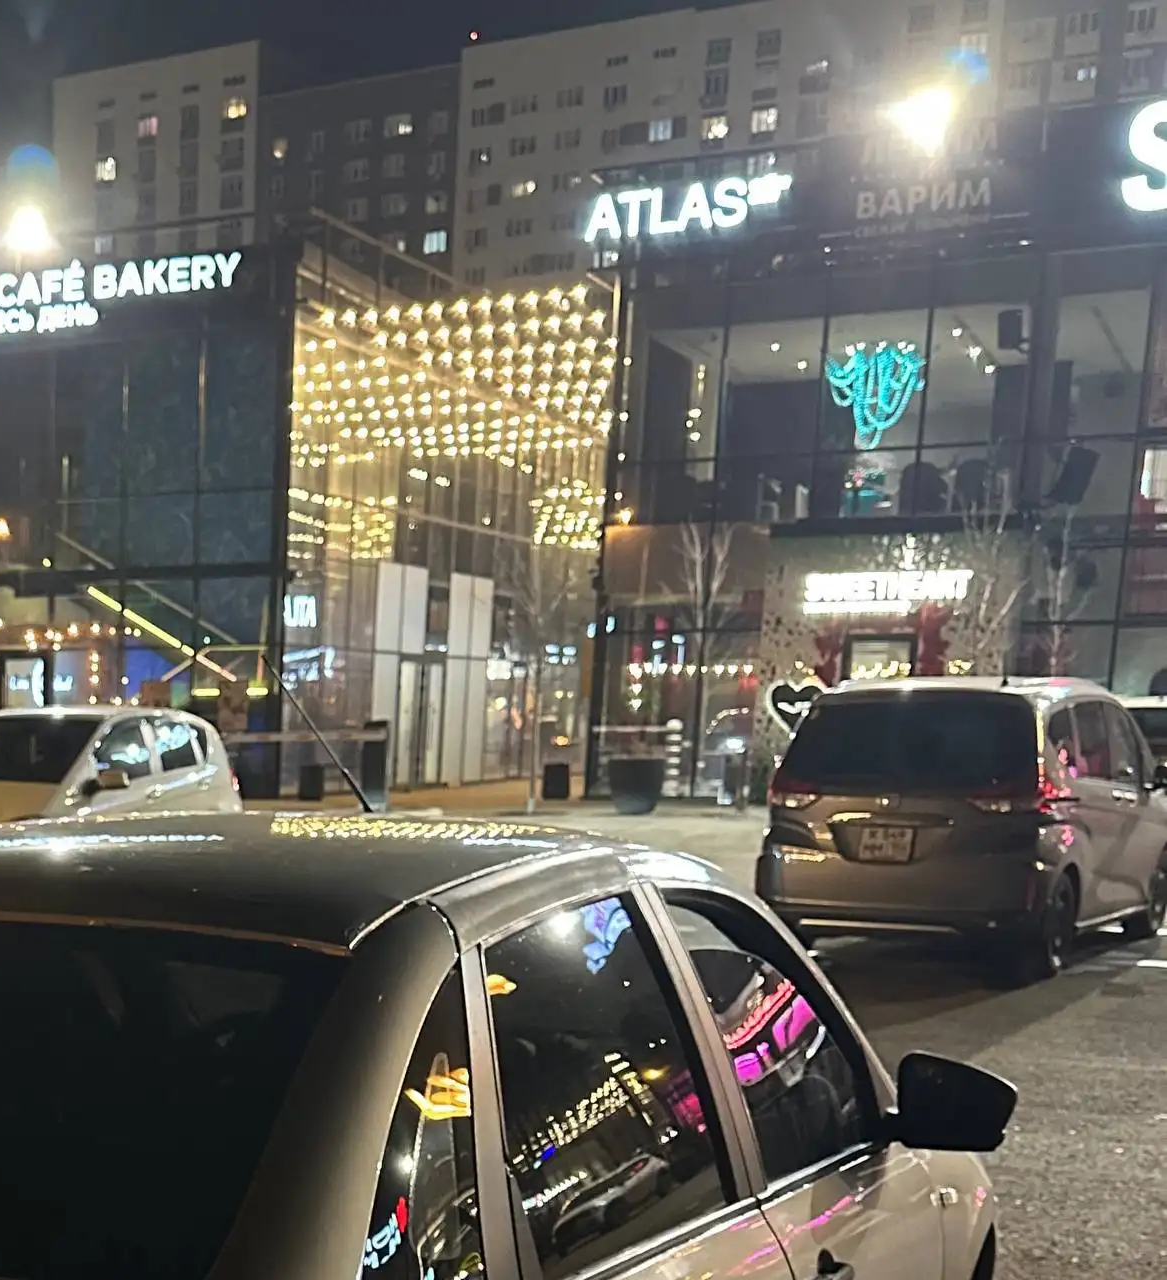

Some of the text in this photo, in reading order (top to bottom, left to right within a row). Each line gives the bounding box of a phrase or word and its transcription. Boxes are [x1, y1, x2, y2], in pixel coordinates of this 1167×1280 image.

[584, 177, 748, 243] ATLAS
[856, 177, 991, 220] ВАРИМ
[93, 252, 242, 299] BAKERY
